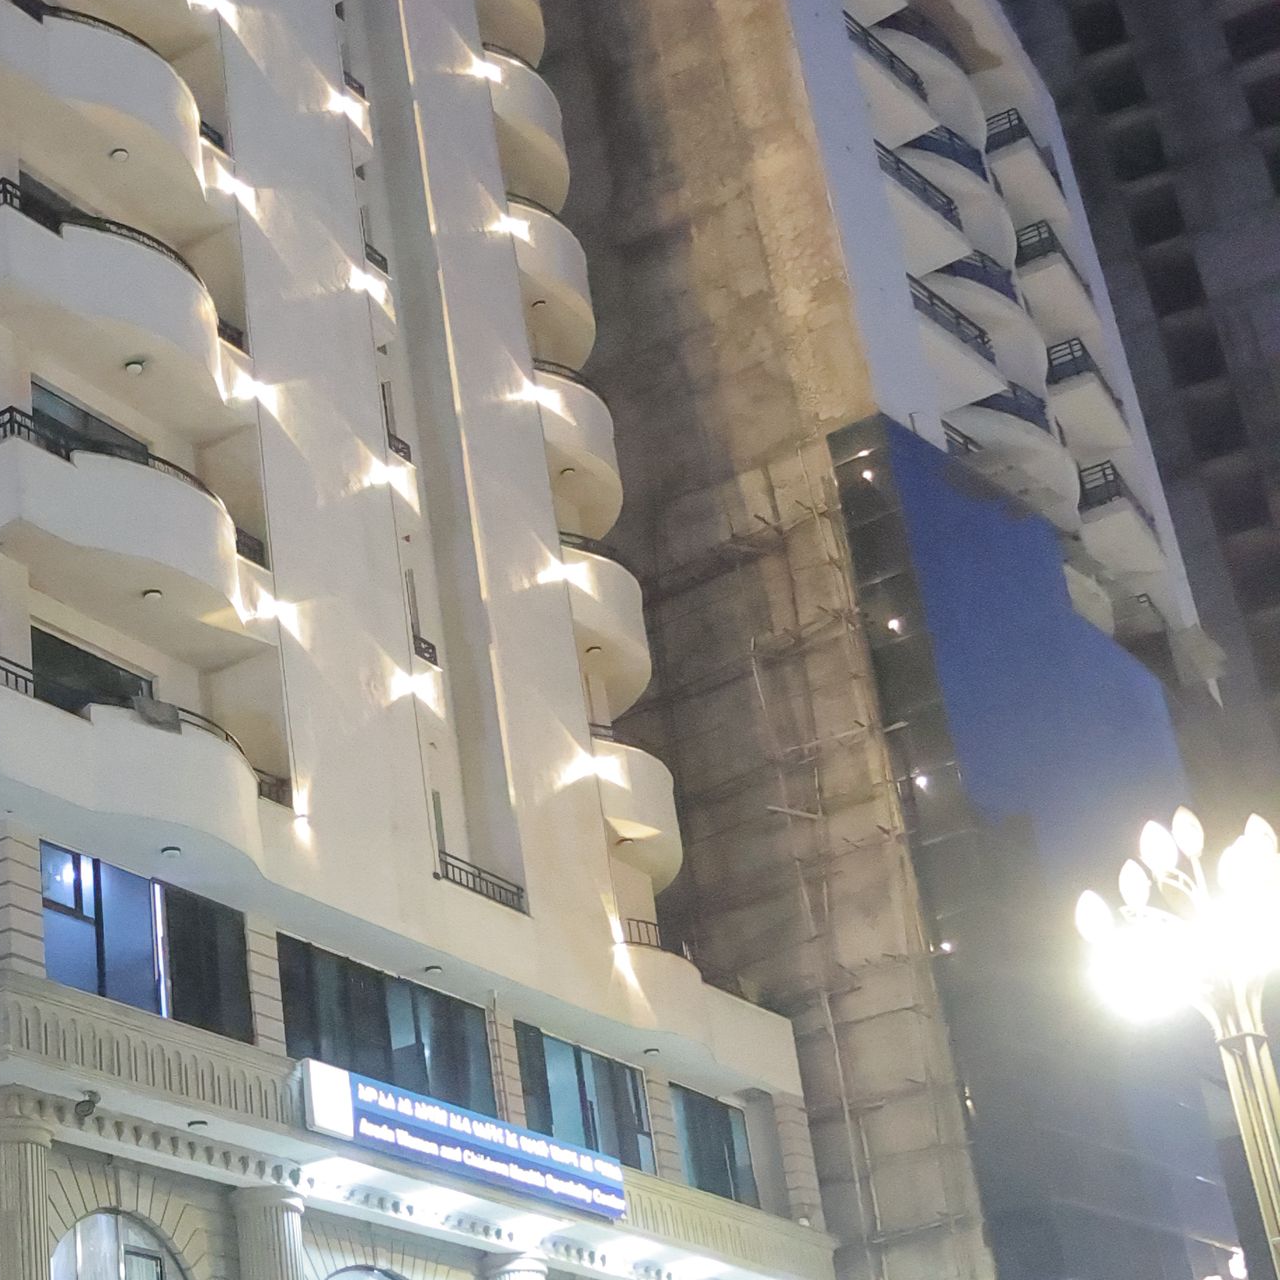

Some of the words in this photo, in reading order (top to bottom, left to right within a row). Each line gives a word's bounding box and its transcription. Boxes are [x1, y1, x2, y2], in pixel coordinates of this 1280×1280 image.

[396, 1129, 439, 1155] Women
[440, 1146, 462, 1161] and
[463, 1150, 510, 1176] Children
[509, 1164, 545, 1187] Health
[594, 1189, 626, 1211] Center
